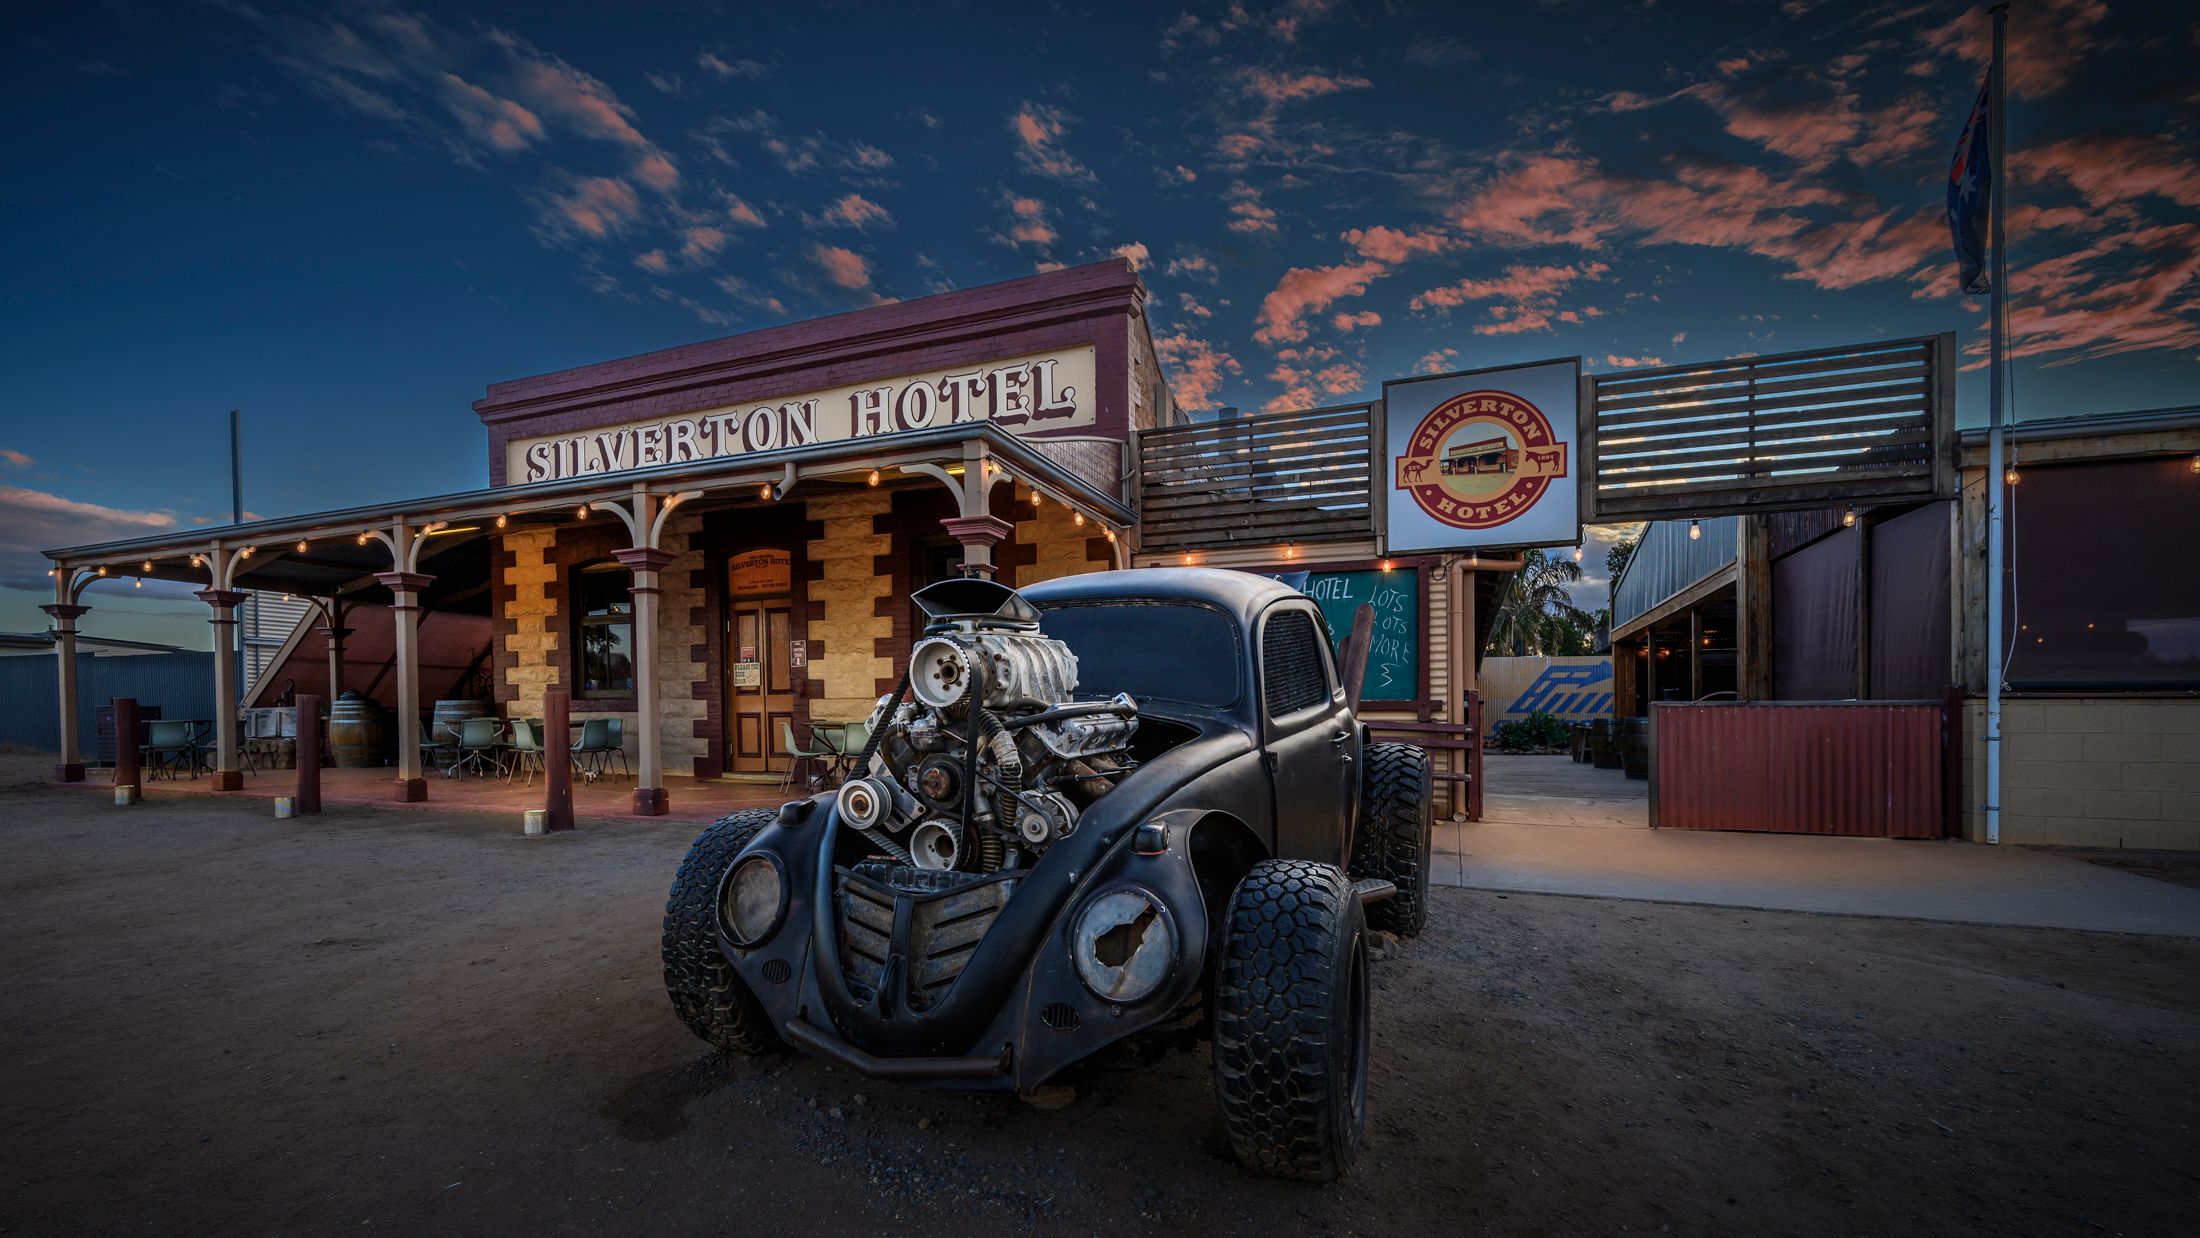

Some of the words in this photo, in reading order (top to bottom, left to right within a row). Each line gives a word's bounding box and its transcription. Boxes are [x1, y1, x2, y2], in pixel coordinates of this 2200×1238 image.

[526, 398, 820, 482] SILVERTON
[852, 358, 1076, 438] HOTEL
[1419, 399, 1541, 450] SILVERTON
[1437, 492, 1527, 519] HOTEL
[731, 559, 769, 571] SILVERTON
[1303, 577, 1353, 600] HOTEL
[1368, 585, 1409, 612] LOTS
[1368, 634, 1410, 664] MORE
